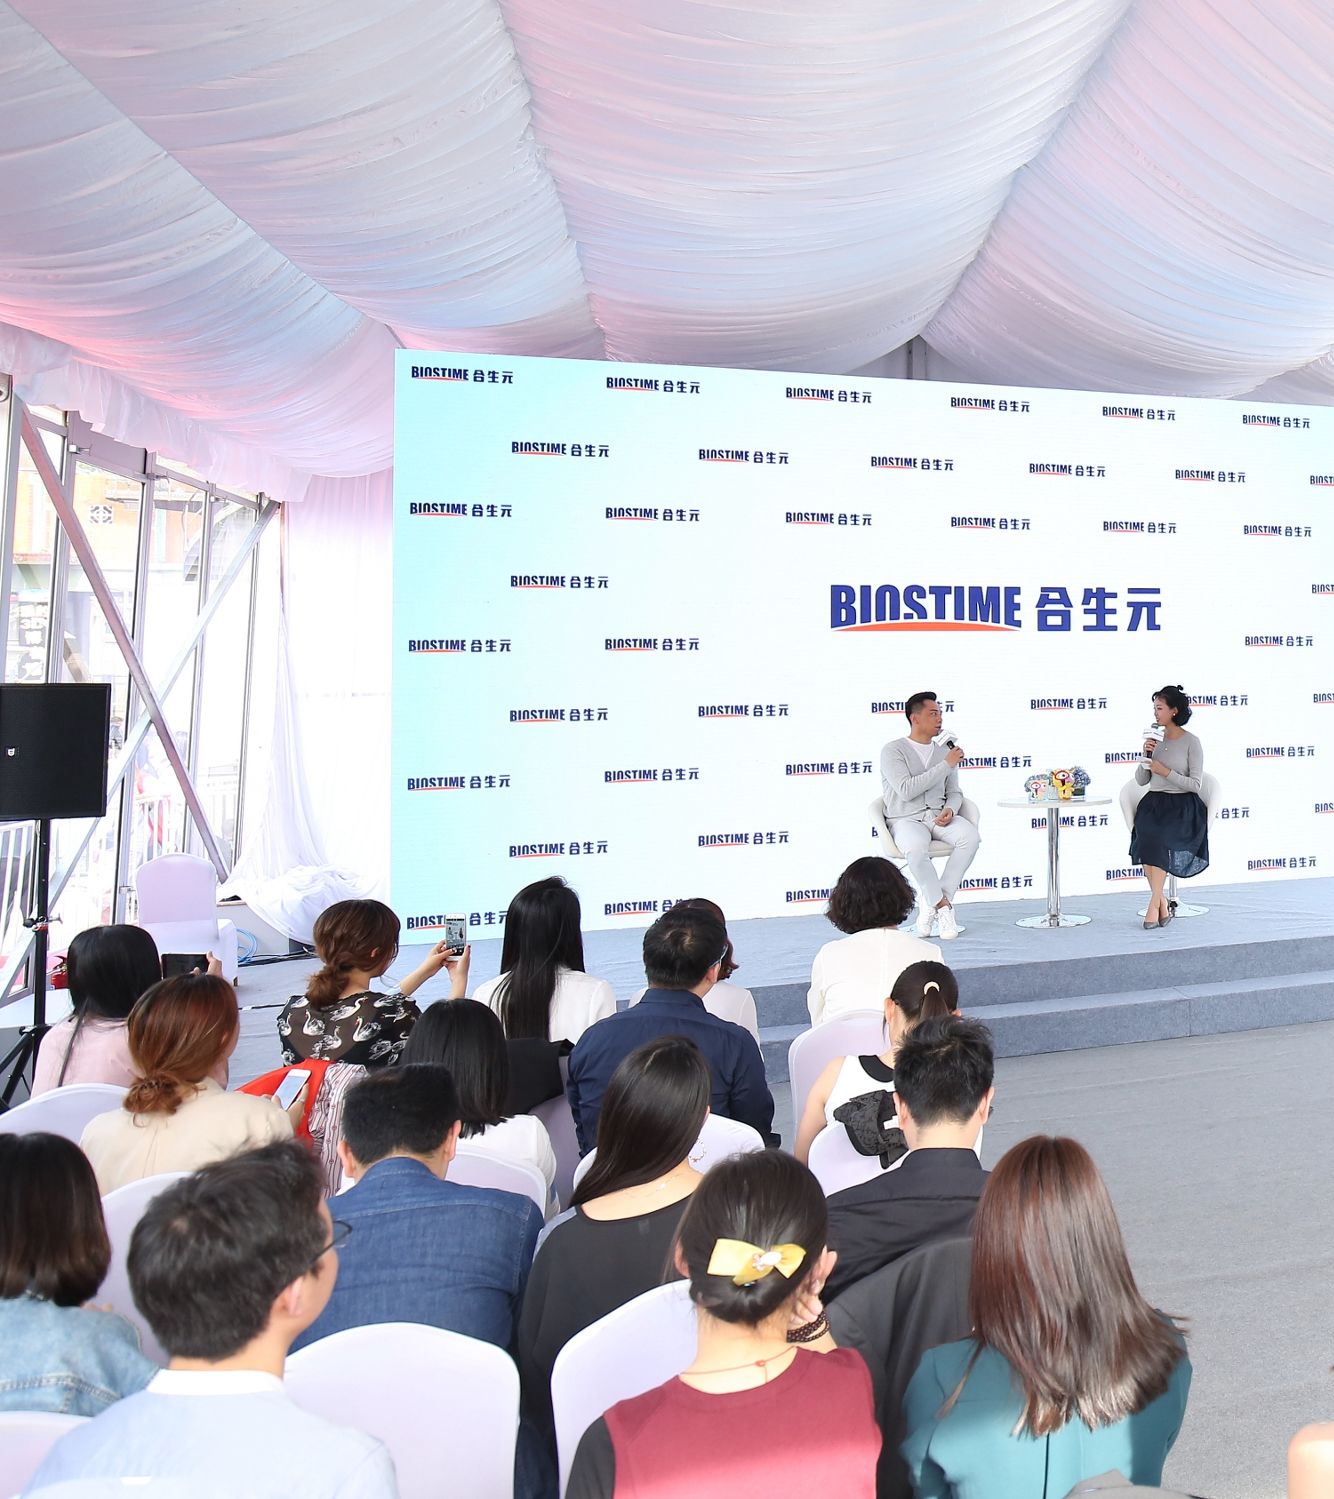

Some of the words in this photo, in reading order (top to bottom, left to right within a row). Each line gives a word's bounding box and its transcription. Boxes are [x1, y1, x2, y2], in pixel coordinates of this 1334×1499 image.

[412, 366, 469, 380] BIOSTIME
[473, 370, 513, 384] 合生元
[607, 377, 659, 390] BIOSTIME
[663, 380, 700, 393] 合生元
[786, 387, 834, 400] BIOSTIME
[838, 391, 871, 403] 合生元
[951, 397, 995, 409] BIOSTIME
[999, 400, 1030, 412] 合生元
[1103, 406, 1143, 418] BIOSTIME
[1147, 409, 1175, 420] 合生元
[1243, 415, 1280, 426] BIOSTIME
[1284, 417, 1310, 428] 合生元
[512, 442, 566, 455] BIOSTIME
[571, 444, 609, 457] 合生元
[699, 449, 749, 461] BIOSTIME
[754, 451, 788, 464] 合生元
[871, 456, 917, 468] BIOSTIME
[921, 459, 953, 470] 合生元
[1030, 463, 1072, 475] BIOSTIME
[1075, 465, 1105, 477] 合生元
[1176, 470, 1214, 480] BIOSTIME
[1218, 471, 1245, 483] 合生元
[410, 502, 467, 515] BIOSTIME
[472, 504, 512, 517] 合生元
[606, 507, 658, 520] BIOSTIME
[663, 509, 699, 521] 合生元
[786, 512, 834, 524] BIOSTIME
[838, 514, 871, 526] 合生元
[951, 517, 995, 528] BIOSTIME
[999, 518, 1030, 530] 合生元
[1103, 521, 1144, 532] BIOSTIME
[1148, 522, 1176, 533] 合生元
[1244, 525, 1282, 535] BIOSTIME
[1285, 526, 1311, 537] 合生元
[511, 576, 565, 587] BIOSTIME
[570, 576, 608, 588] 合生元
[831, 585, 1021, 629] BIOSTIME
[1036, 587, 1161, 631] 合生元
[409, 640, 466, 652] BIOSTIME
[471, 640, 511, 652] 合生元
[605, 639, 658, 650] BIOSTIME
[662, 638, 699, 650] 合生元
[1245, 636, 1283, 646] BIOSTIME
[1286, 636, 1312, 646] 合生元
[872, 702, 907, 713] BIOSTI
[1031, 699, 1073, 709] BIOSTIME
[1077, 698, 1106, 709] 合生元
[1188, 696, 1217, 706] OSTIME
[1220, 695, 1248, 706] 合生元
[510, 709, 565, 722] BIOSTIME
[570, 708, 608, 721] 合生元
[698, 705, 749, 717] BIOSTIME
[753, 704, 788, 716] 合生元
[1247, 747, 1284, 758] BIOSTIME
[1288, 746, 1314, 757] 合生元
[786, 763, 834, 775] BIOSTIME
[838, 761, 872, 774] 合生元
[1000, 756, 1031, 768] 合生元
[605, 769, 657, 782] BIOSTIME
[662, 768, 699, 781] 合生元
[408, 777, 465, 790] BIOSTIME
[470, 775, 510, 789] 合生元
[1222, 807, 1249, 819] 合生元
[1032, 817, 1074, 829] BIOIME
[1078, 815, 1108, 827] 合生元
[698, 833, 749, 846] BIOSTIME
[753, 831, 788, 844] 合生元
[509, 843, 565, 857] BIOSTIME
[569, 841, 608, 855] 合生元
[1248, 858, 1286, 870] BIOSTIME
[1290, 856, 1316, 868] 合生元
[1106, 868, 1146, 880] BIOSTIM
[1001, 876, 1032, 888] 合生元
[786, 889, 832, 902] BIOSTIM
[605, 901, 657, 915] BIOSTIME
[407, 915, 446, 929] BIOST
